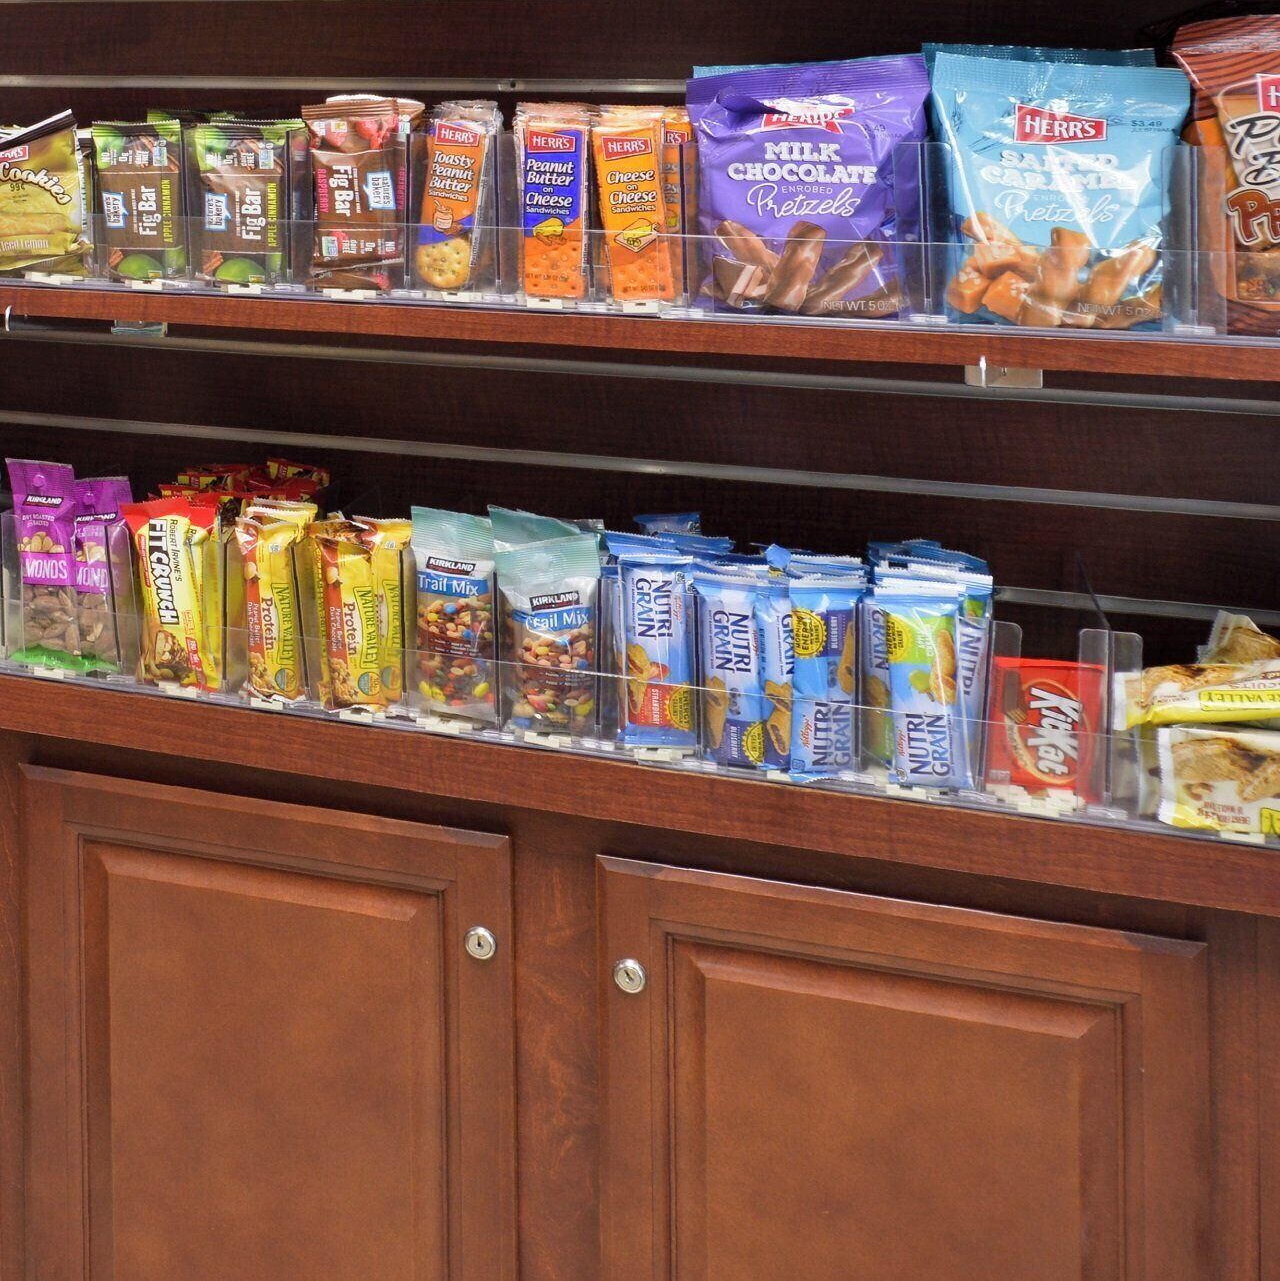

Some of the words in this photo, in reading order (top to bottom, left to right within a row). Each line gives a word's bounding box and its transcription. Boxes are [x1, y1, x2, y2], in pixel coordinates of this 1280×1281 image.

[1022, 113, 1098, 139] HERR'S
[439, 128, 476, 145] HERR'S
[531, 135, 571, 149] HERR'S
[607, 139, 647, 156] HERR'S
[763, 141, 841, 163] MILK
[433, 151, 475, 168] Toasty
[526, 158, 574, 173] Peanut
[430, 164, 474, 181] Peanut
[527, 172, 574, 186] Butter
[606, 169, 655, 185] Cheese
[726, 162, 878, 185] CHOCOLATE
[429, 177, 472, 193] Butter
[782, 185, 833, 195] ENROBED
[525, 192, 573, 208] Cheese
[609, 189, 657, 205] Cheese
[745, 182, 862, 219] Pretzels
[526, 206, 571, 215] Sandwiches
[610, 203, 656, 213] Sandwiches
[429, 557, 474, 571] KIRKLAND
[418, 574, 447, 592] Trail
[451, 579, 479, 597] Mix
[533, 593, 579, 607] KIRKLAND
[634, 578, 657, 639] GRAIN
[652, 579, 674, 639] NUTRI
[261, 597, 274, 651] Protein
[343, 601, 358, 656] Protein
[712, 609, 734, 674] GRAIN
[728, 612, 752, 674] NUTRI
[812, 701, 829, 766] NUTRI
[909, 713, 925, 777] NUTRI
[931, 712, 951, 778] GRAIN
